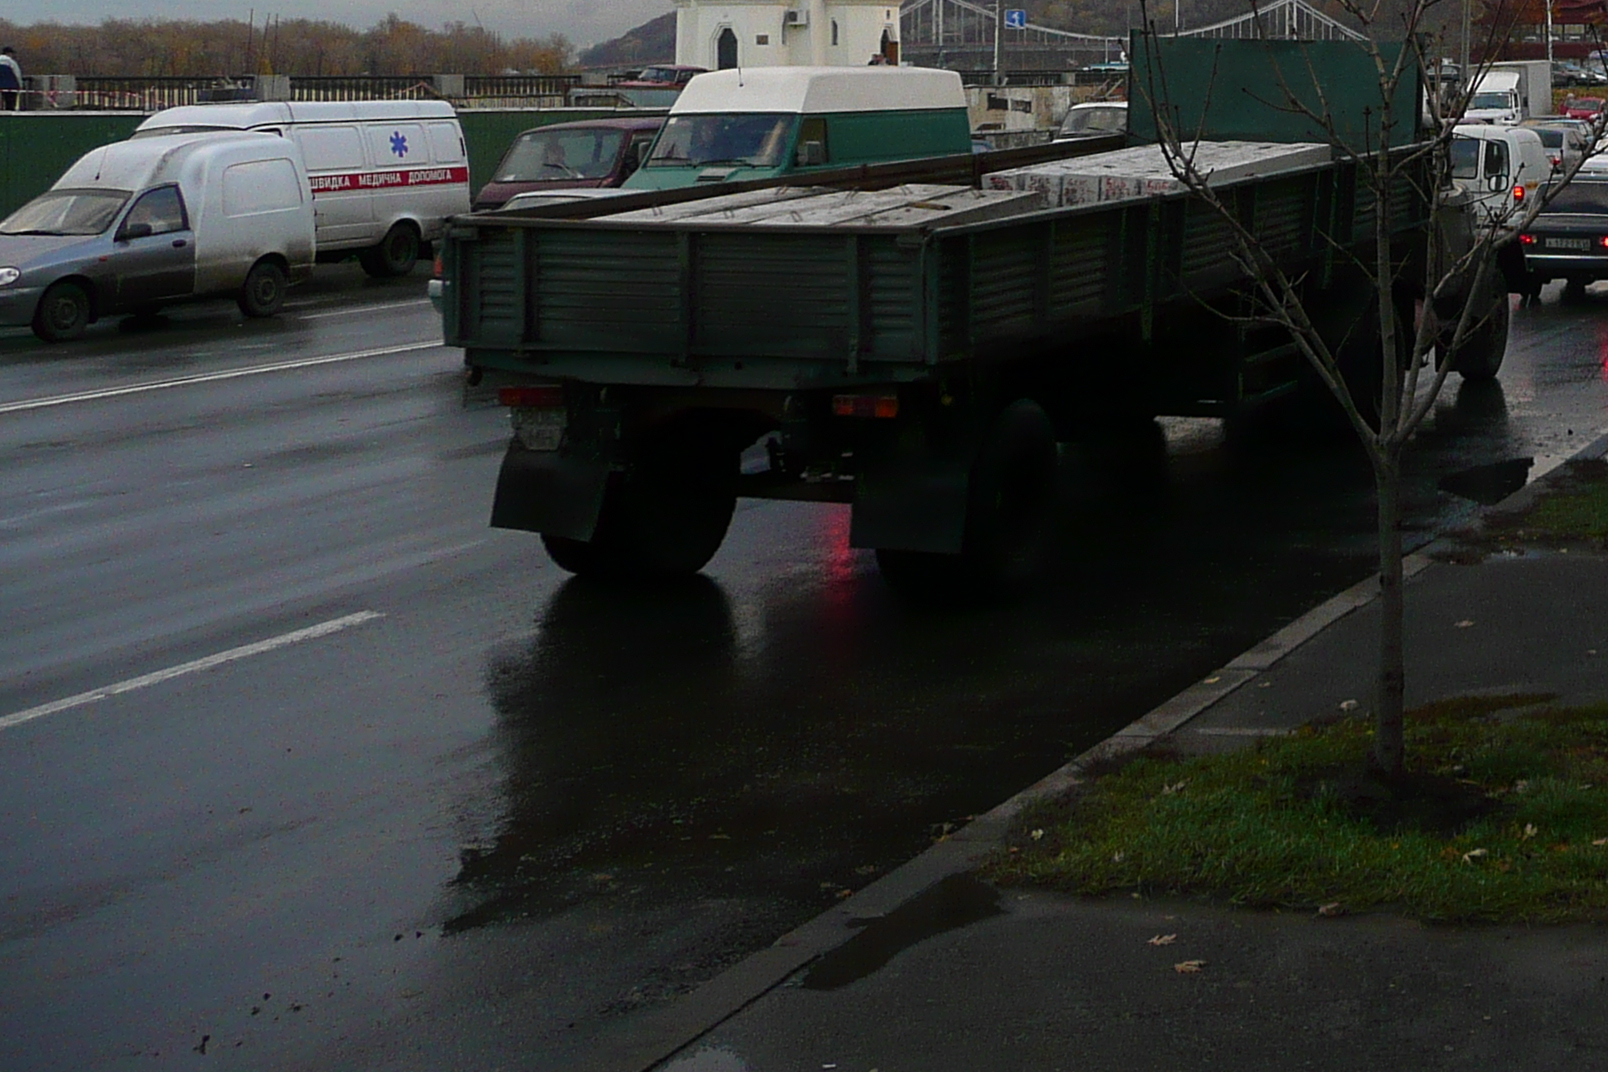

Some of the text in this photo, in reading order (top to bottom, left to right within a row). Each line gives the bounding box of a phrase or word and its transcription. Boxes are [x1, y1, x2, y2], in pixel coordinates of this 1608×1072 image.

[310, 169, 452, 190] ШВИДКА МЕДИЧНА ДОПОМОГА
